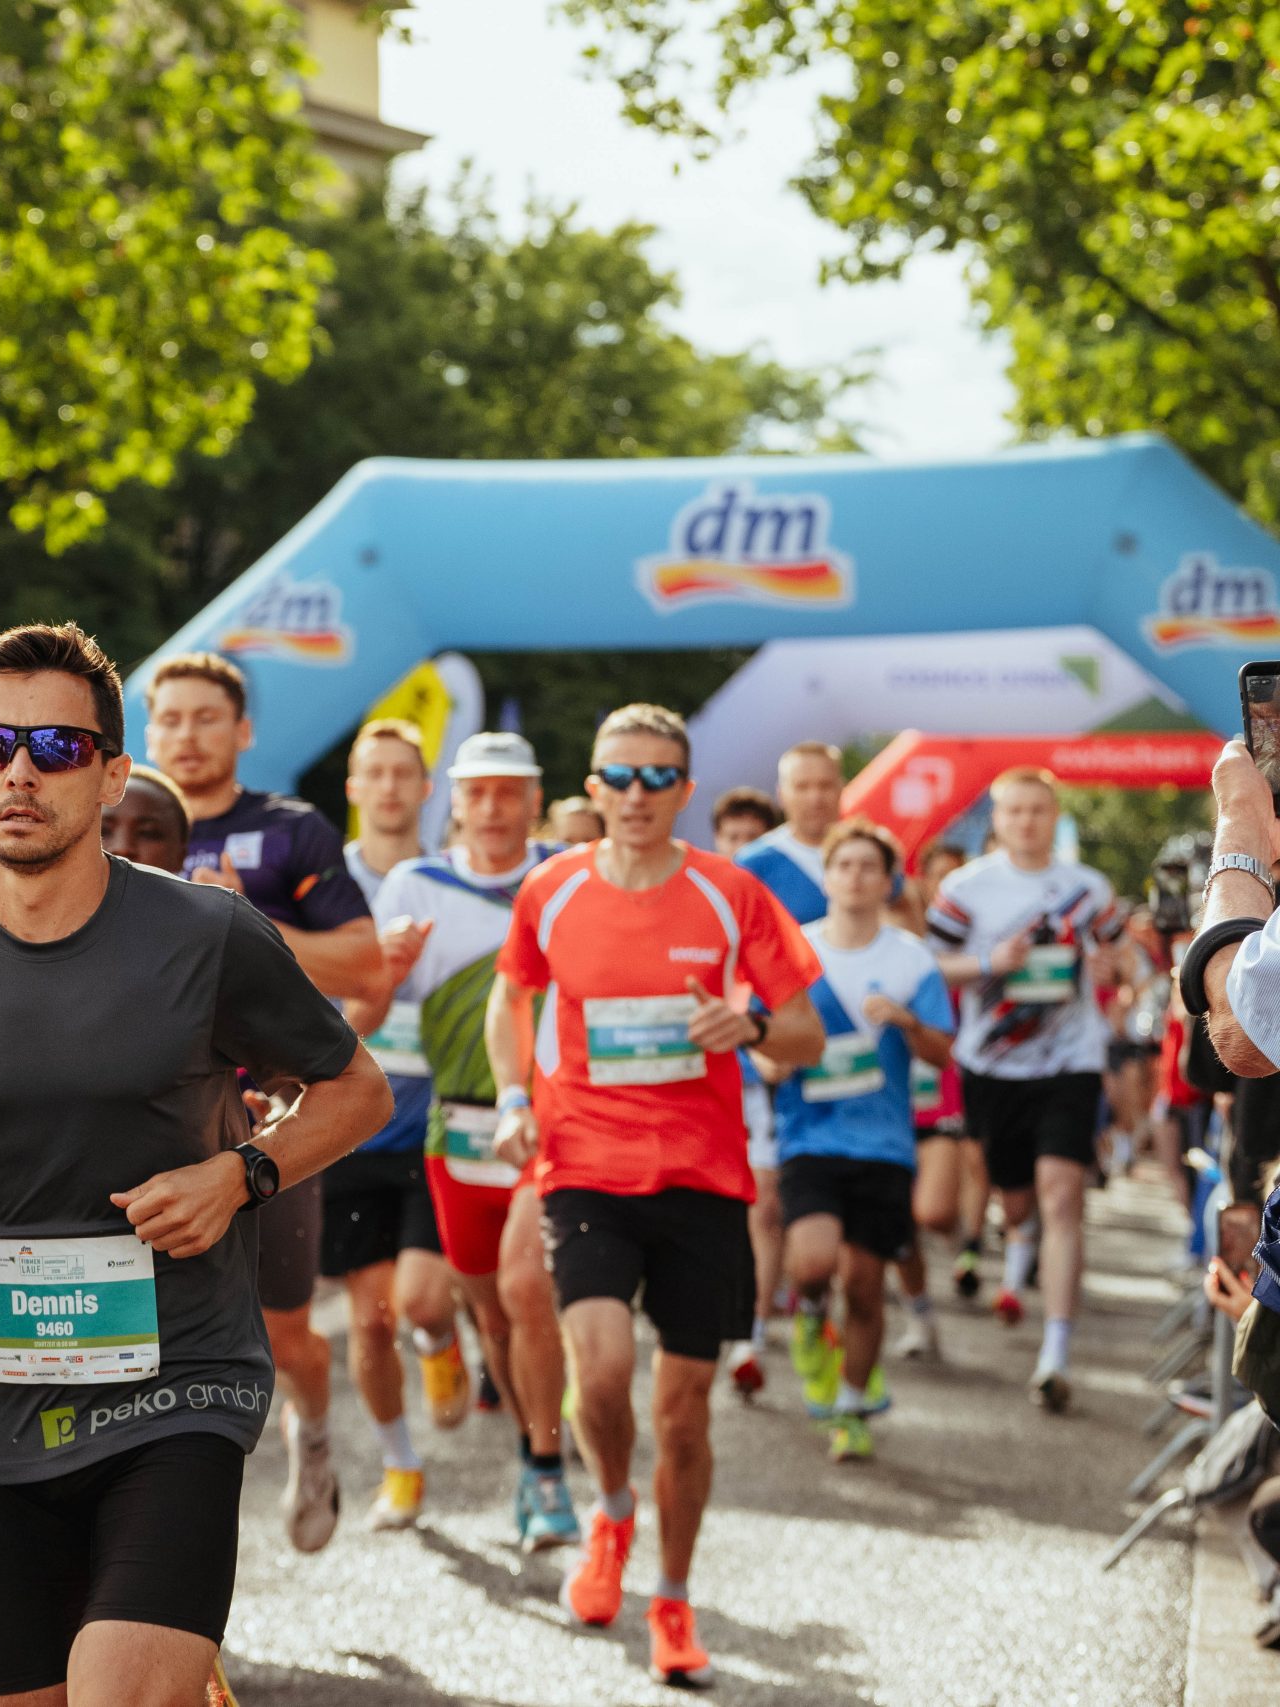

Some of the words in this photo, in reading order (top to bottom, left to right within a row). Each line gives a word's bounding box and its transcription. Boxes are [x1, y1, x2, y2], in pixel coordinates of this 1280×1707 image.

[683, 488, 820, 560] dm
[1168, 562, 1270, 619] dm
[21, 1264, 40, 1274] LAUF
[11, 1289, 99, 1316] Dennis
[36, 1321, 74, 1337] 9460
[89, 1387, 177, 1435] peko
[186, 1381, 268, 1416] gmbh
